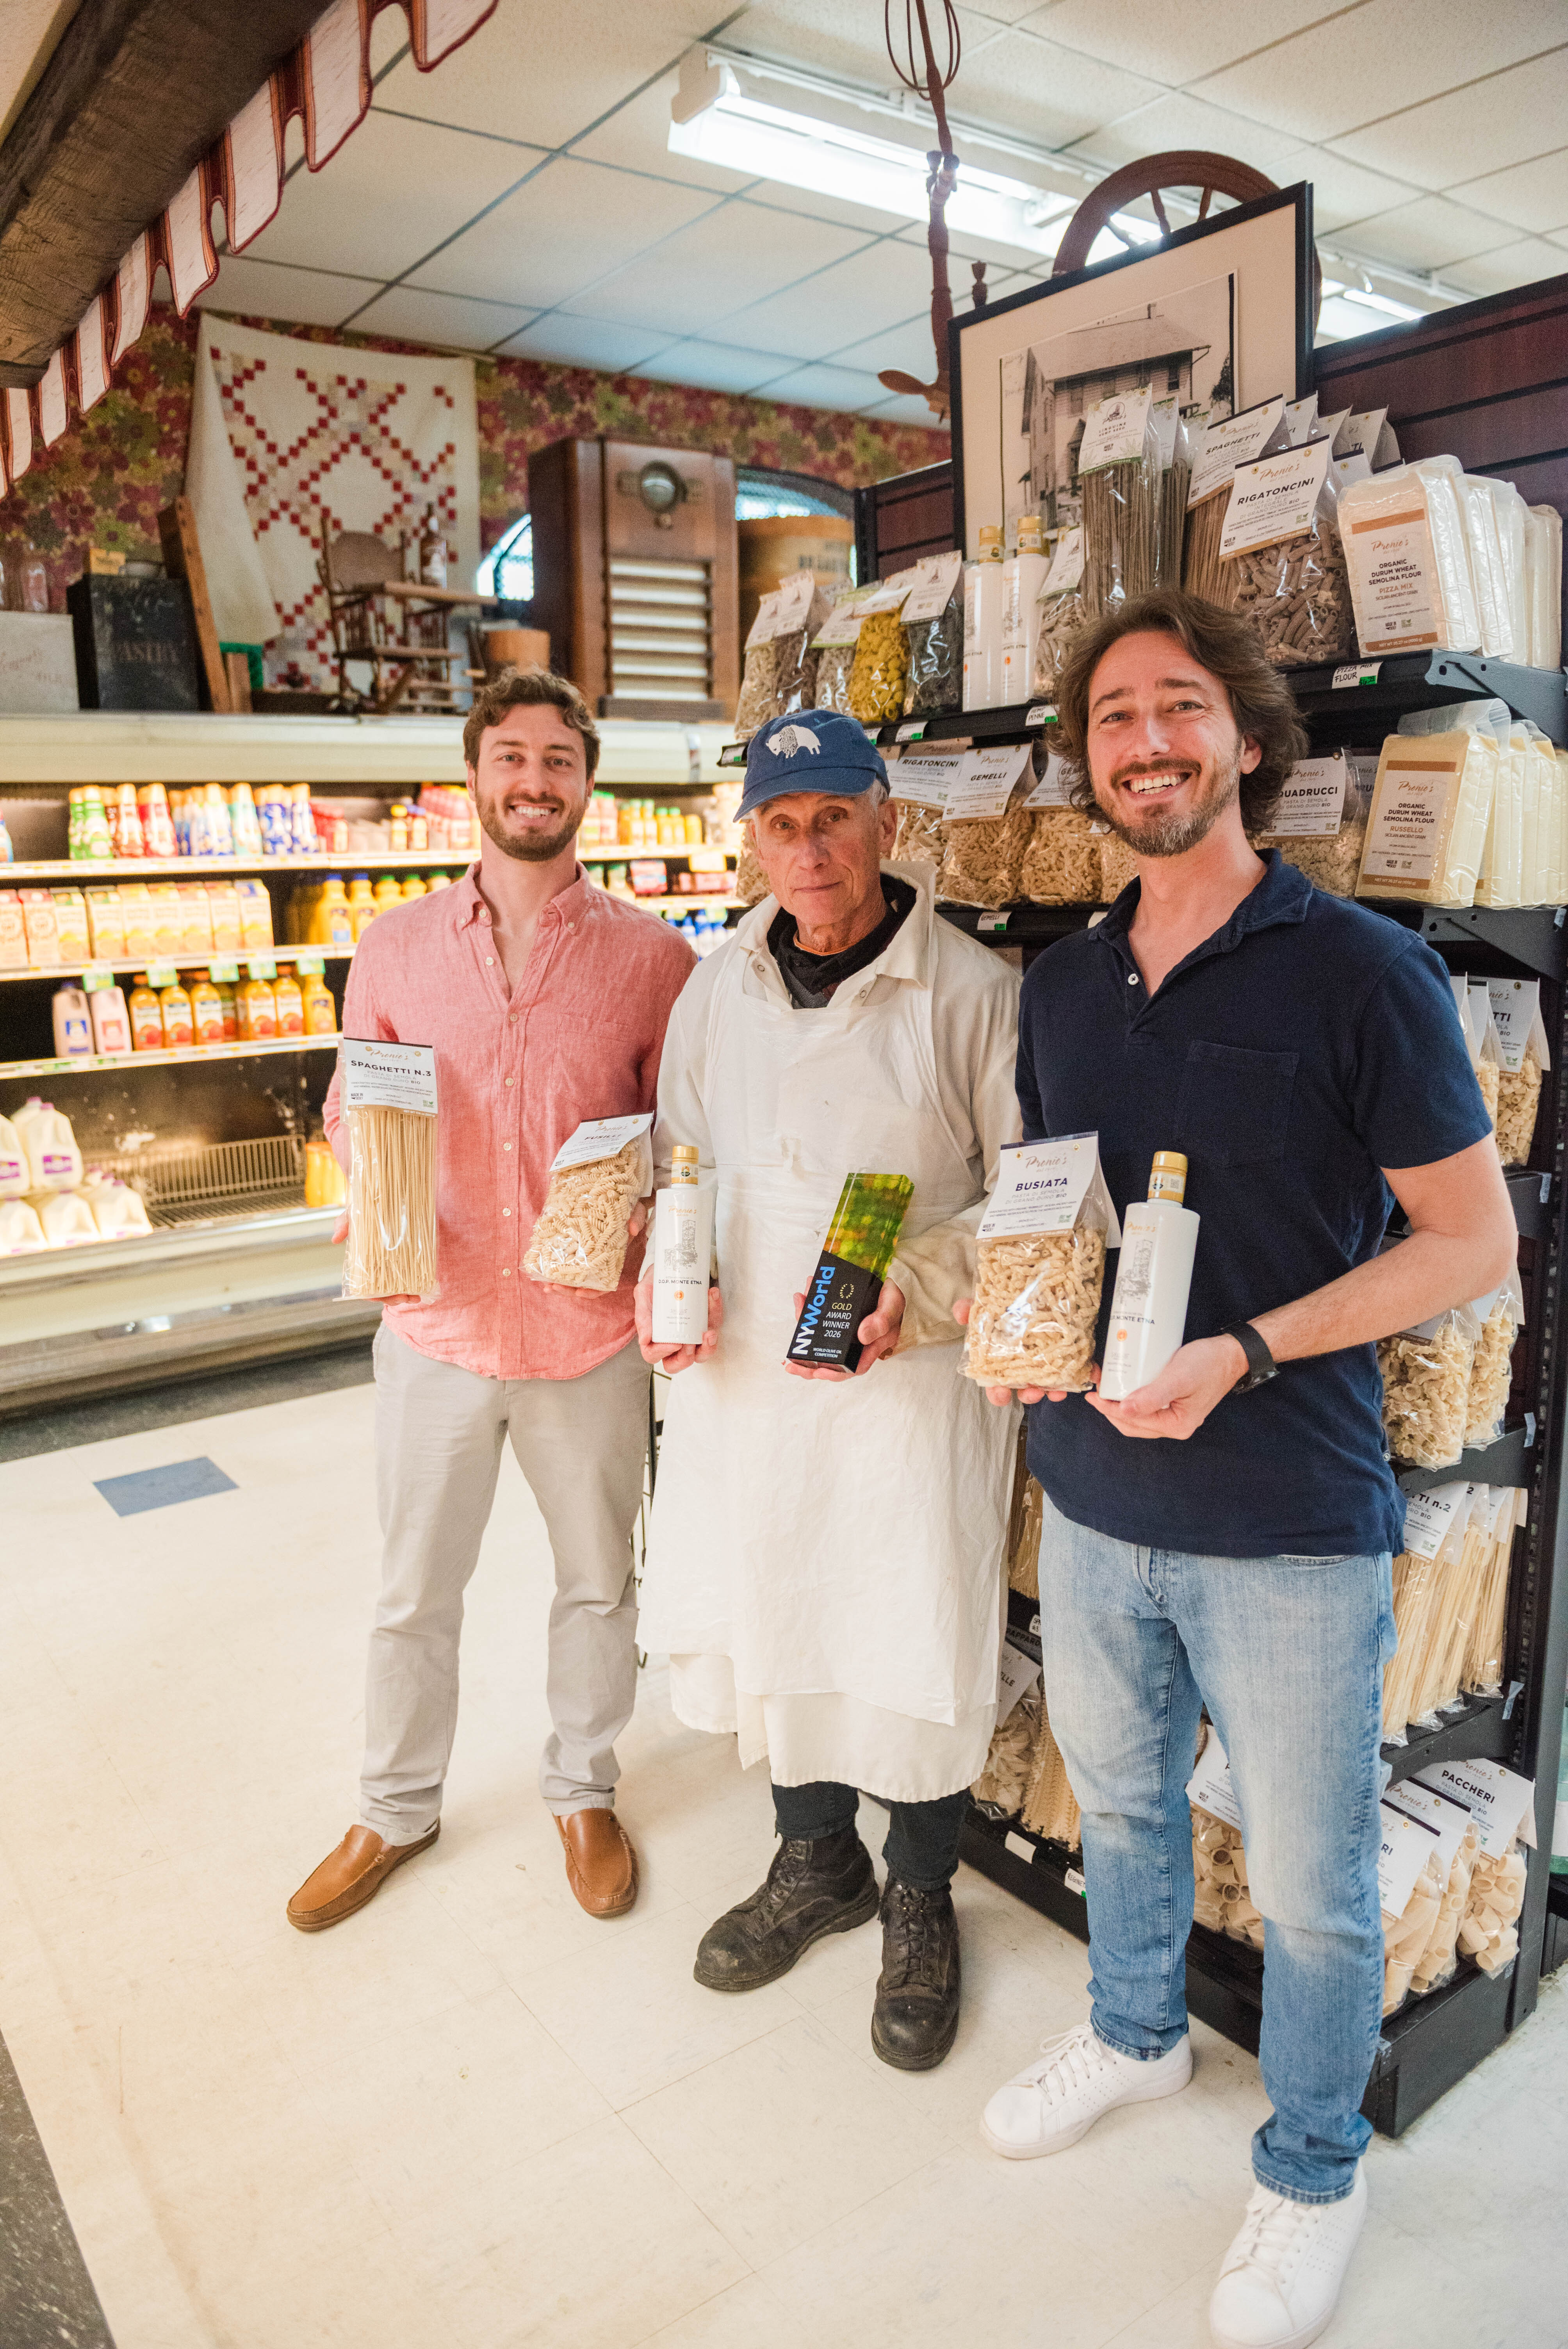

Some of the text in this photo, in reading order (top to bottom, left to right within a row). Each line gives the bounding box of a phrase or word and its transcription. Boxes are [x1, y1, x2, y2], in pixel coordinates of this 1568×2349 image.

[1099, 422, 1126, 433] LINGUINE
[1206, 432, 1260, 455] SPAGHETTI
[1259, 459, 1300, 481] Pronio's
[1237, 478, 1315, 505] RIGATONCINI
[1274, 490, 1299, 501] SEMOLA
[1254, 498, 1287, 510] INTEGRALE
[1371, 536, 1409, 551] Pronio's
[1379, 559, 1408, 569] ORGANIC
[1371, 564, 1417, 578] DURUM WHEAT
[1368, 571, 1422, 585] SEMOLINA FLOUR
[1379, 585, 1399, 594] PIZZA
[1336, 665, 1357, 674] PIZZA
[1335, 672, 1358, 683] FLOUR
[1028, 711, 1045, 721] PENNE
[902, 759, 959, 767] RIGATONCINI
[971, 772, 1007, 781] GEMELLI
[1398, 781, 1434, 793] Pronio's
[1489, 989, 1509, 1000] nio's
[370, 1049, 409, 1061] Pronio's
[351, 1060, 410, 1075] SPAGHETTI
[1025, 1153, 1067, 1169] Pronio's
[1016, 1177, 1068, 1191] BUSIATA
[792, 1266, 836, 1355] NYWorld
[832, 1302, 852, 1310] GOLD
[826, 1311, 852, 1320] AWARD
[822, 1320, 850, 1329] WINNER
[1432, 1501, 1451, 1512] n.2
[1457, 1761, 1492, 1780] ronio's
[1441, 1770, 1495, 1804] PACCHERI
[1441, 1781, 1457, 1793] PASTA
[1465, 1793, 1486, 1809] SEMOLA
